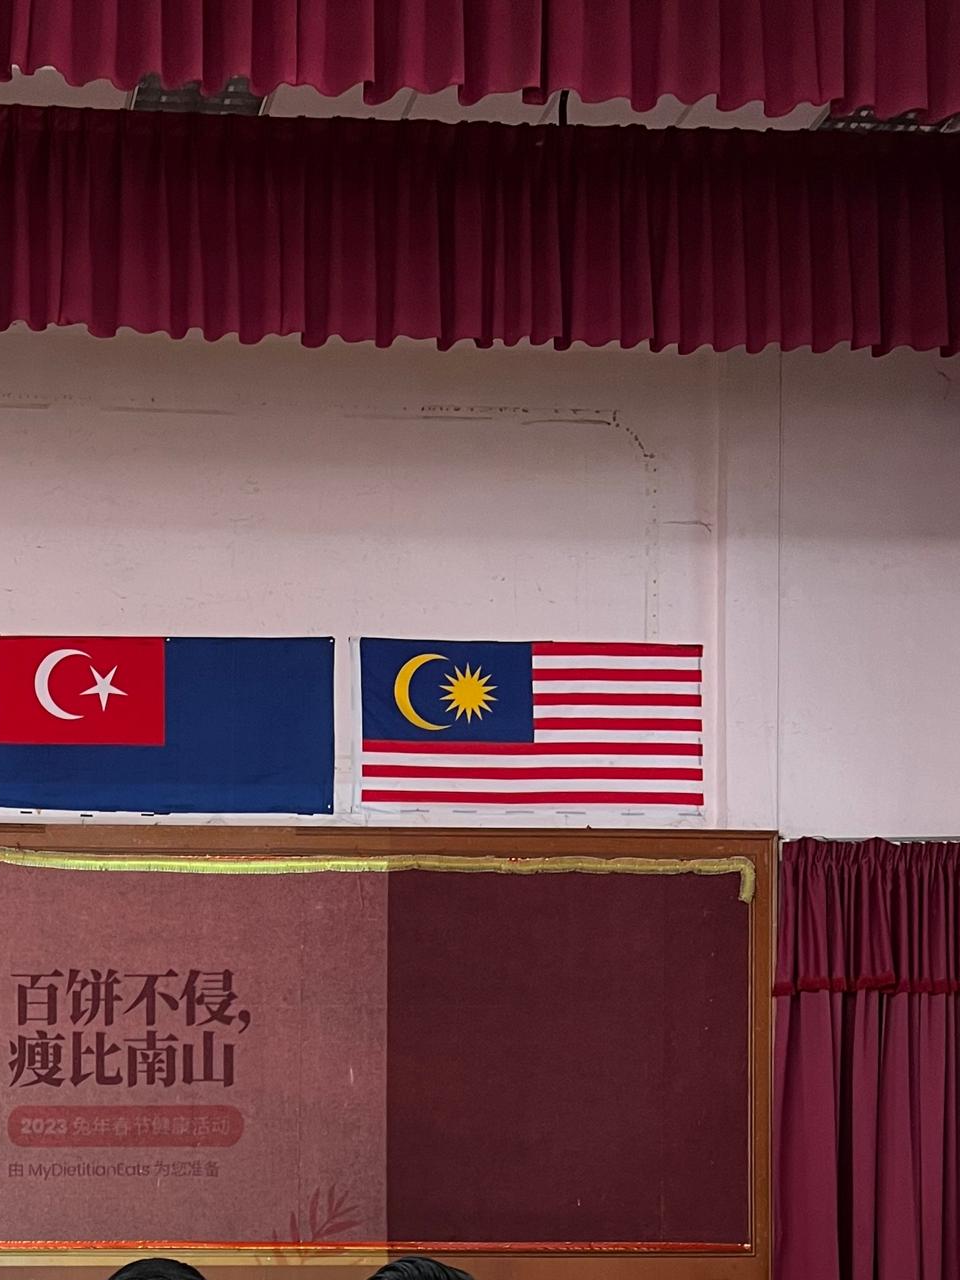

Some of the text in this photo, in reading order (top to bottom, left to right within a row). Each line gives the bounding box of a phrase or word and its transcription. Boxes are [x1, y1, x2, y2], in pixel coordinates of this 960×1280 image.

[10, 968, 251, 1034] 百饼不侵,
[8, 1029, 236, 1088] 瘦比南山
[20, 1117, 68, 1136] 2023
[8, 1160, 220, 1180] 由 MyDietitianEats 为您准备
